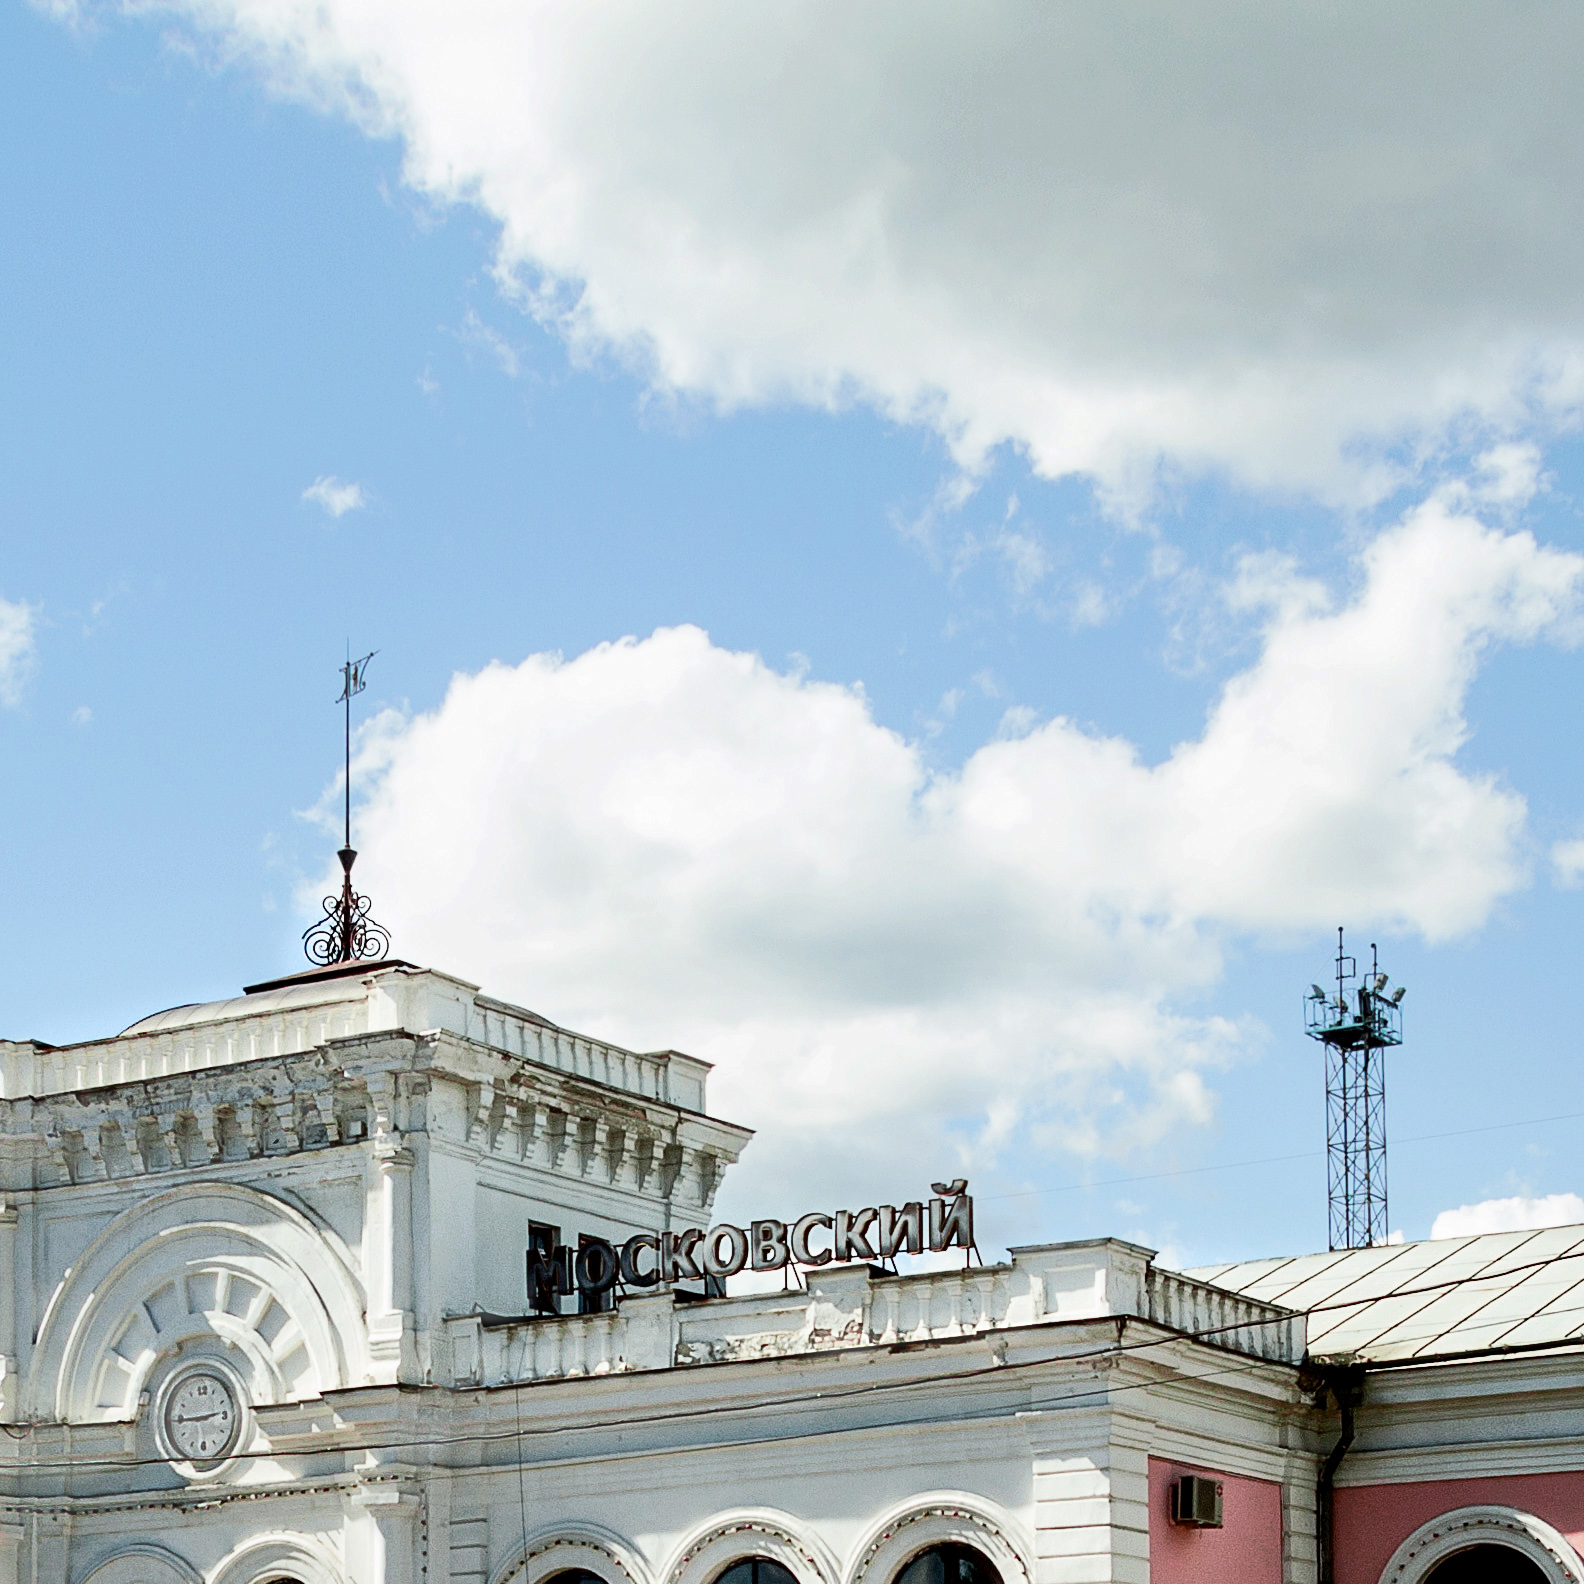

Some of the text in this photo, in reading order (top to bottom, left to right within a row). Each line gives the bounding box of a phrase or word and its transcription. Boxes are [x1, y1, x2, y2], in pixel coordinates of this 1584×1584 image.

[527, 1178, 974, 1297] МОСКОВСКИЙ
[197, 1385, 208, 1396] 12
[221, 1410, 228, 1420] 3
[200, 1441, 207, 1451] 6
